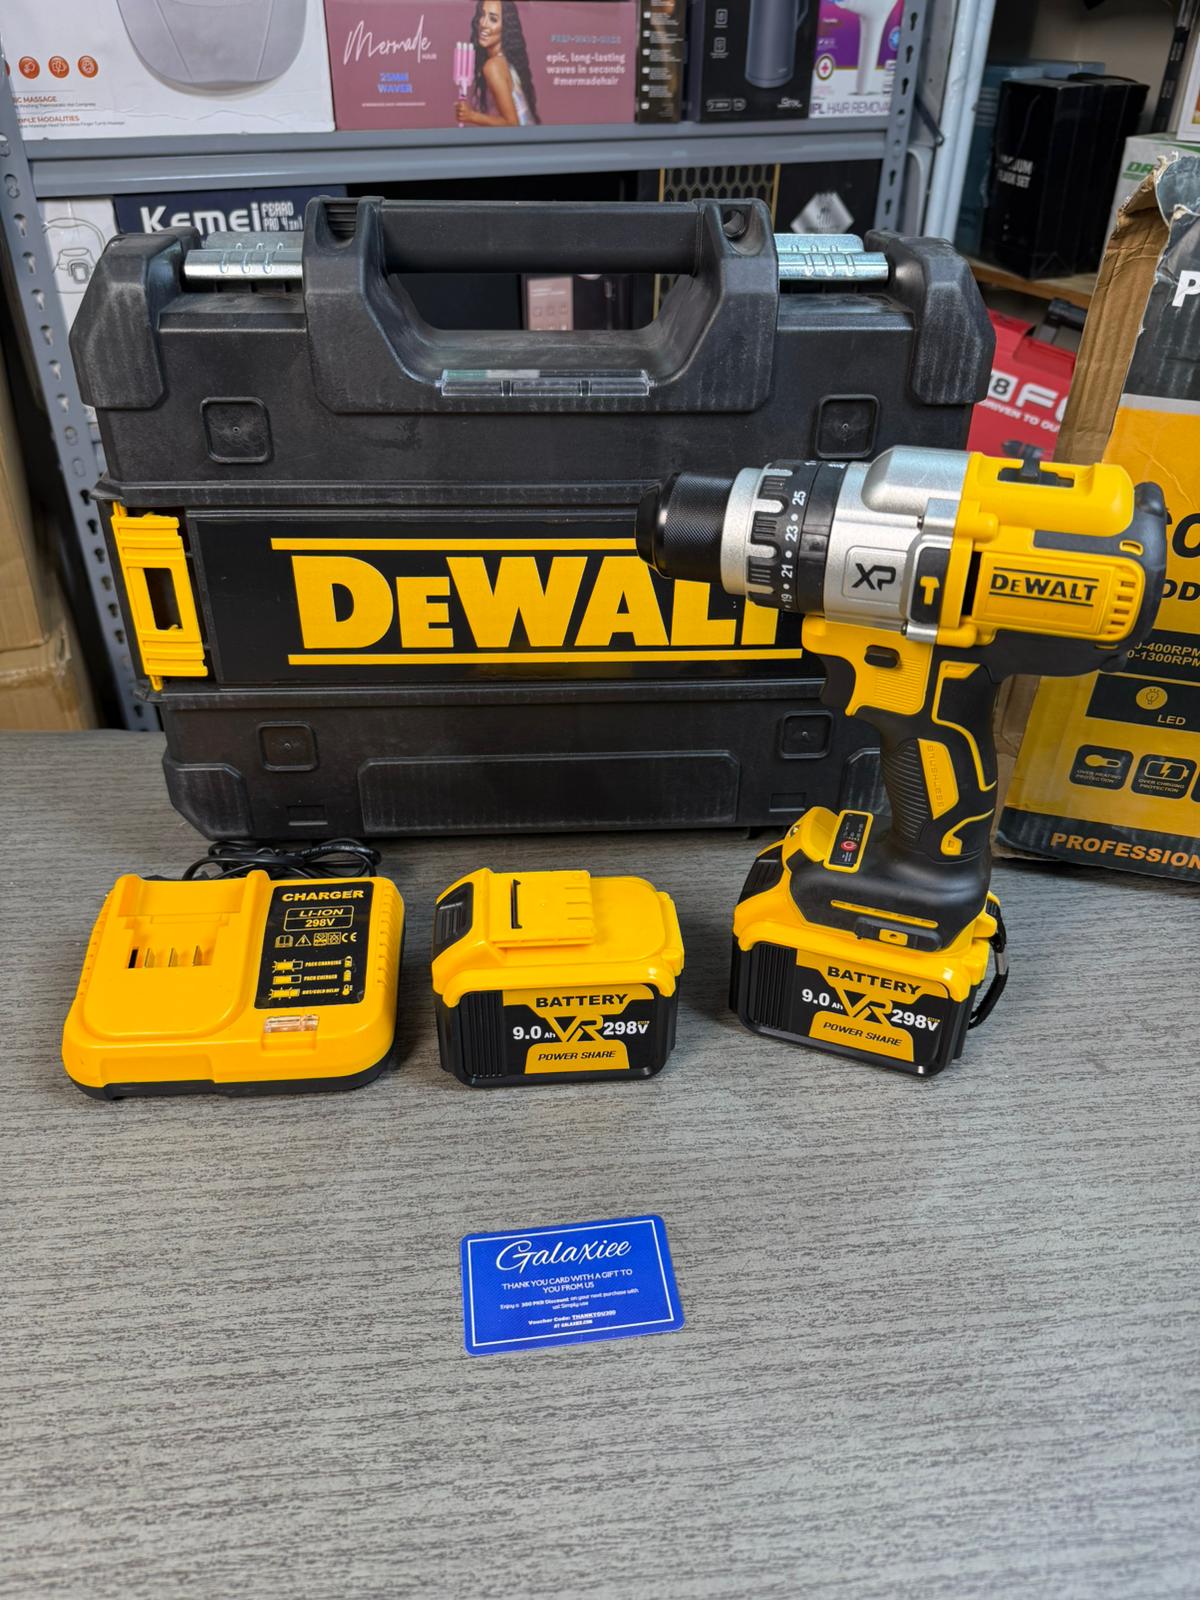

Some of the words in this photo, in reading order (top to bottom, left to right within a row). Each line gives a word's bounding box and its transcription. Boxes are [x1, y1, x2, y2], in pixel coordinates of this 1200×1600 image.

[343, 14, 431, 65] Mermade
[546, 53, 569, 64] epic,
[570, 53, 625, 64] long-lasting
[577, 64, 587, 74] in
[589, 65, 625, 74] seconds
[553, 76, 619, 86] #mermadehair
[140, 202, 262, 235] Kemei
[1023, 413, 1040, 426] TO
[792, 490, 806, 506] 25
[785, 525, 799, 543] 23
[781, 564, 793, 579] 21
[852, 563, 896, 591] XP
[1157, 714, 1186, 726] LED
[282, 890, 364, 901] CHARGER
[300, 909, 344, 917] LI-ION
[305, 918, 335, 928] 298V
[827, 966, 922, 995] BATTERY
[535, 994, 628, 1008] BATTERY
[801, 988, 831, 1006] 9.0
[513, 1025, 541, 1040] 9.0
[823, 1022, 863, 1038] POWER
[865, 1032, 902, 1047] SHARE
[538, 1052, 578, 1061] POWER
[581, 1050, 616, 1060] SHARE
[496, 1240, 632, 1273] Galaxiee
[502, 1282, 530, 1290] THANK
[531, 1279, 548, 1288] YOU
[549, 1277, 569, 1285] CARD
[571, 1273, 594, 1281] WITH
[595, 1272, 601, 1280] A
[602, 1270, 619, 1278] GIFT
[620, 1268, 633, 1276] TO
[543, 1286, 561, 1294] YOU
[561, 1283, 583, 1291] FROM
[584, 1281, 595, 1289] US
[545, 1297, 569, 1305] Discount
[603, 1290, 626, 1298] purchase
[528, 1317, 553, 1325] Voucher
